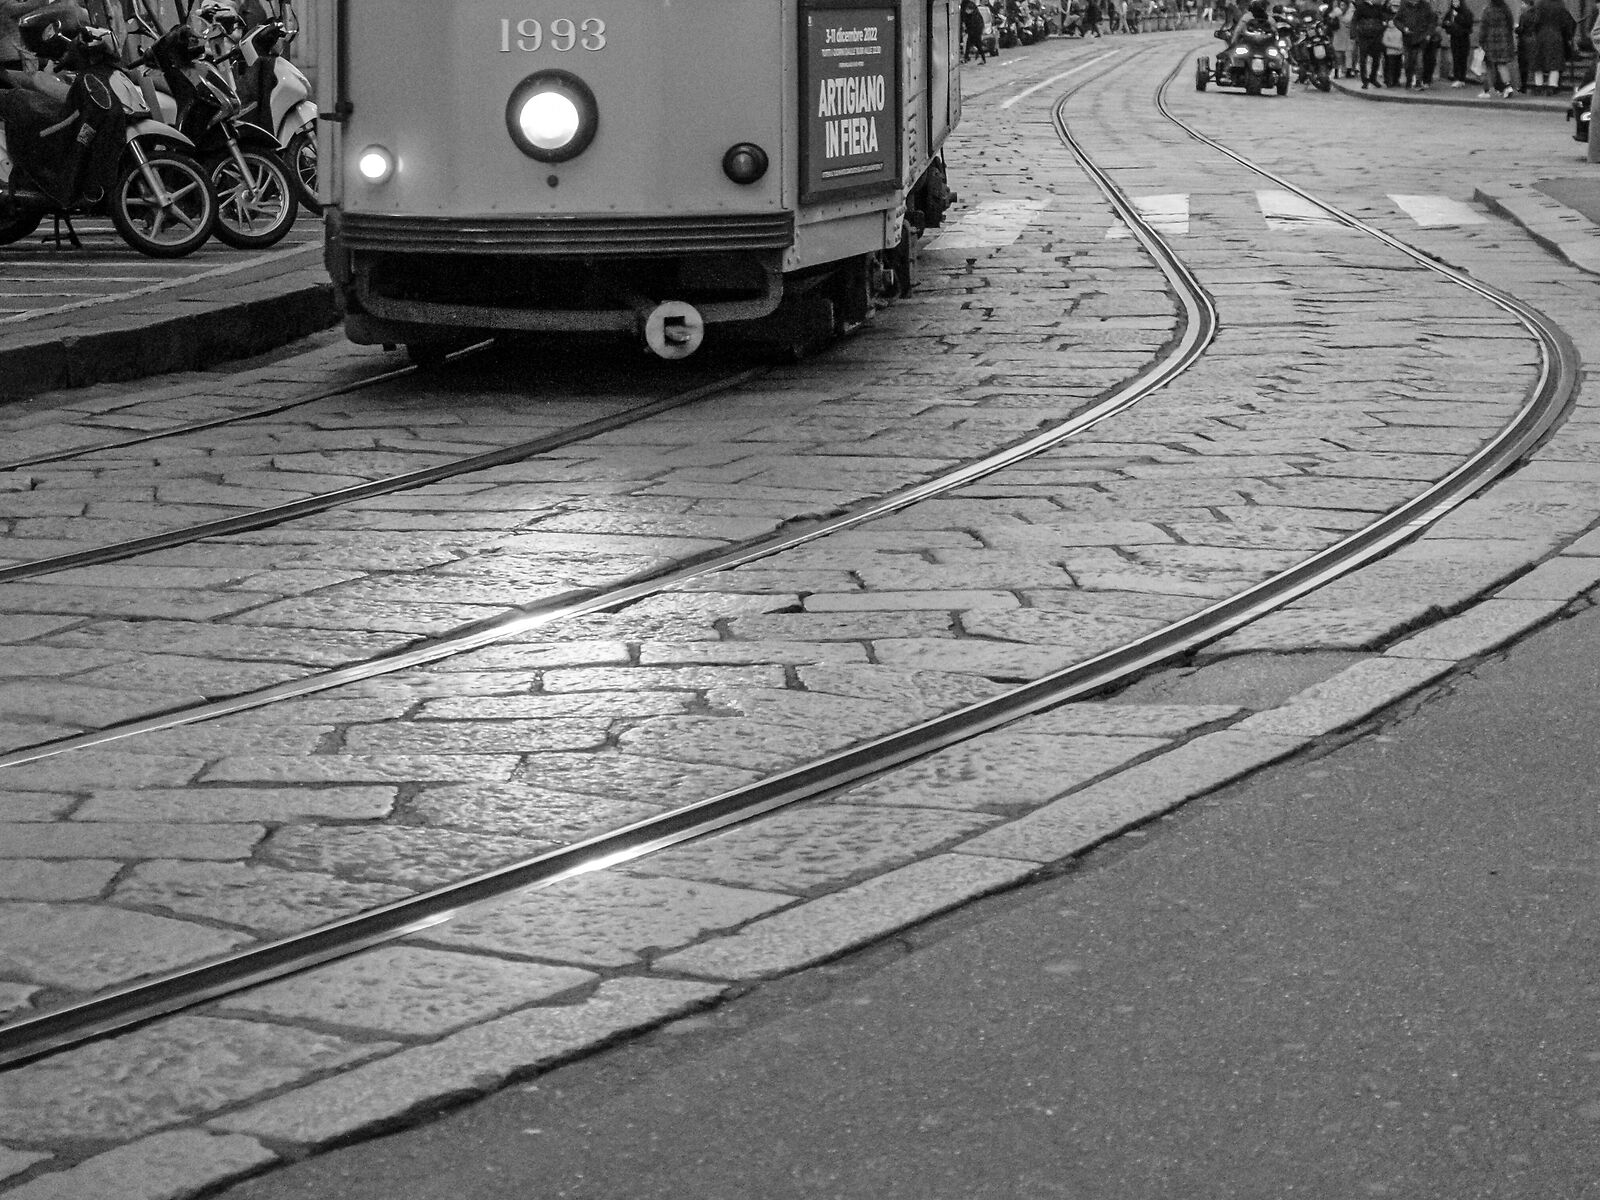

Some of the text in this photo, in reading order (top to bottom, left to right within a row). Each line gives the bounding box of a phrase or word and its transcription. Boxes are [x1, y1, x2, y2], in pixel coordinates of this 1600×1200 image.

[500, 18, 607, 52] 1993
[836, 27, 864, 43] dicembre
[818, 74, 885, 118] ARTIGIANO
[825, 116, 879, 158] IN FIERA
